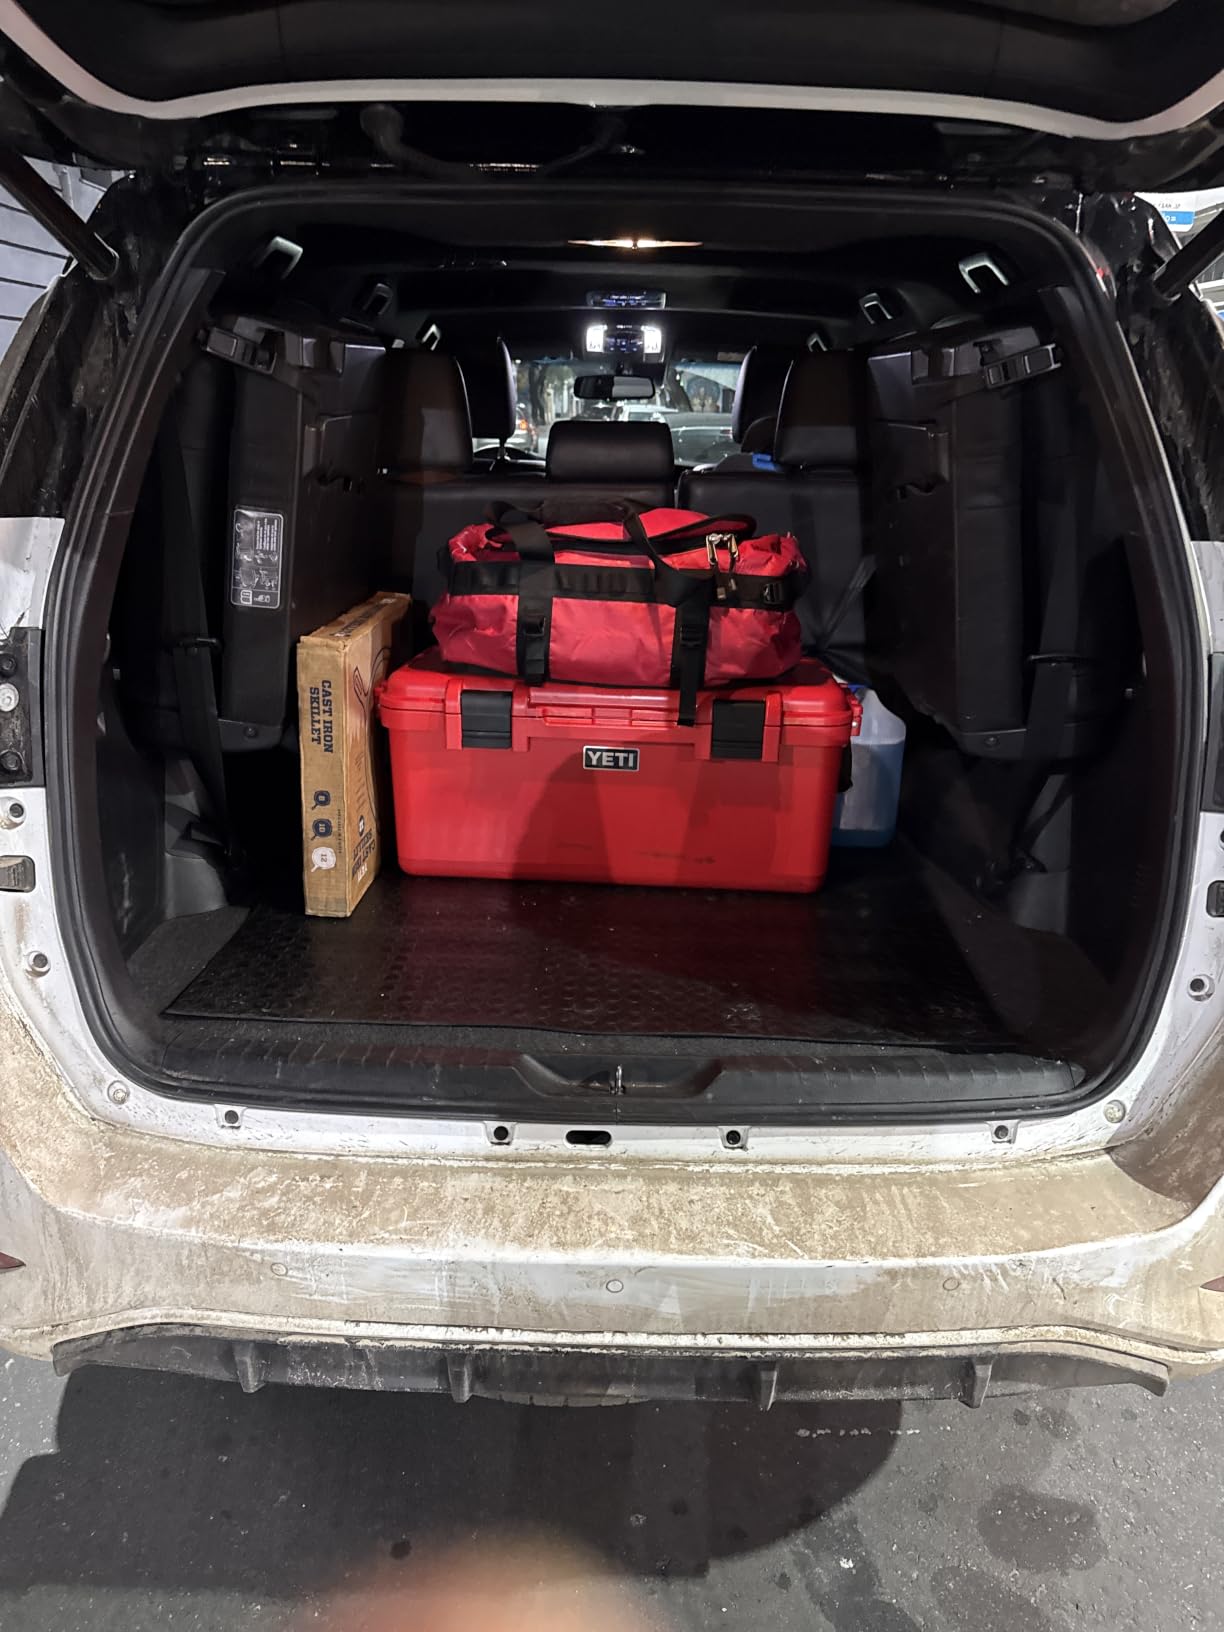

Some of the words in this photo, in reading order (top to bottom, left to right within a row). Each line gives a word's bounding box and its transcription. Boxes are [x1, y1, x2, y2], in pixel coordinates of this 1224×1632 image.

[322, 680, 333, 717] CAST
[310, 687, 321, 745] SKILLET
[323, 720, 333, 753] IRON
[587, 751, 634, 767] YETI
[320, 853, 328, 863] 12
